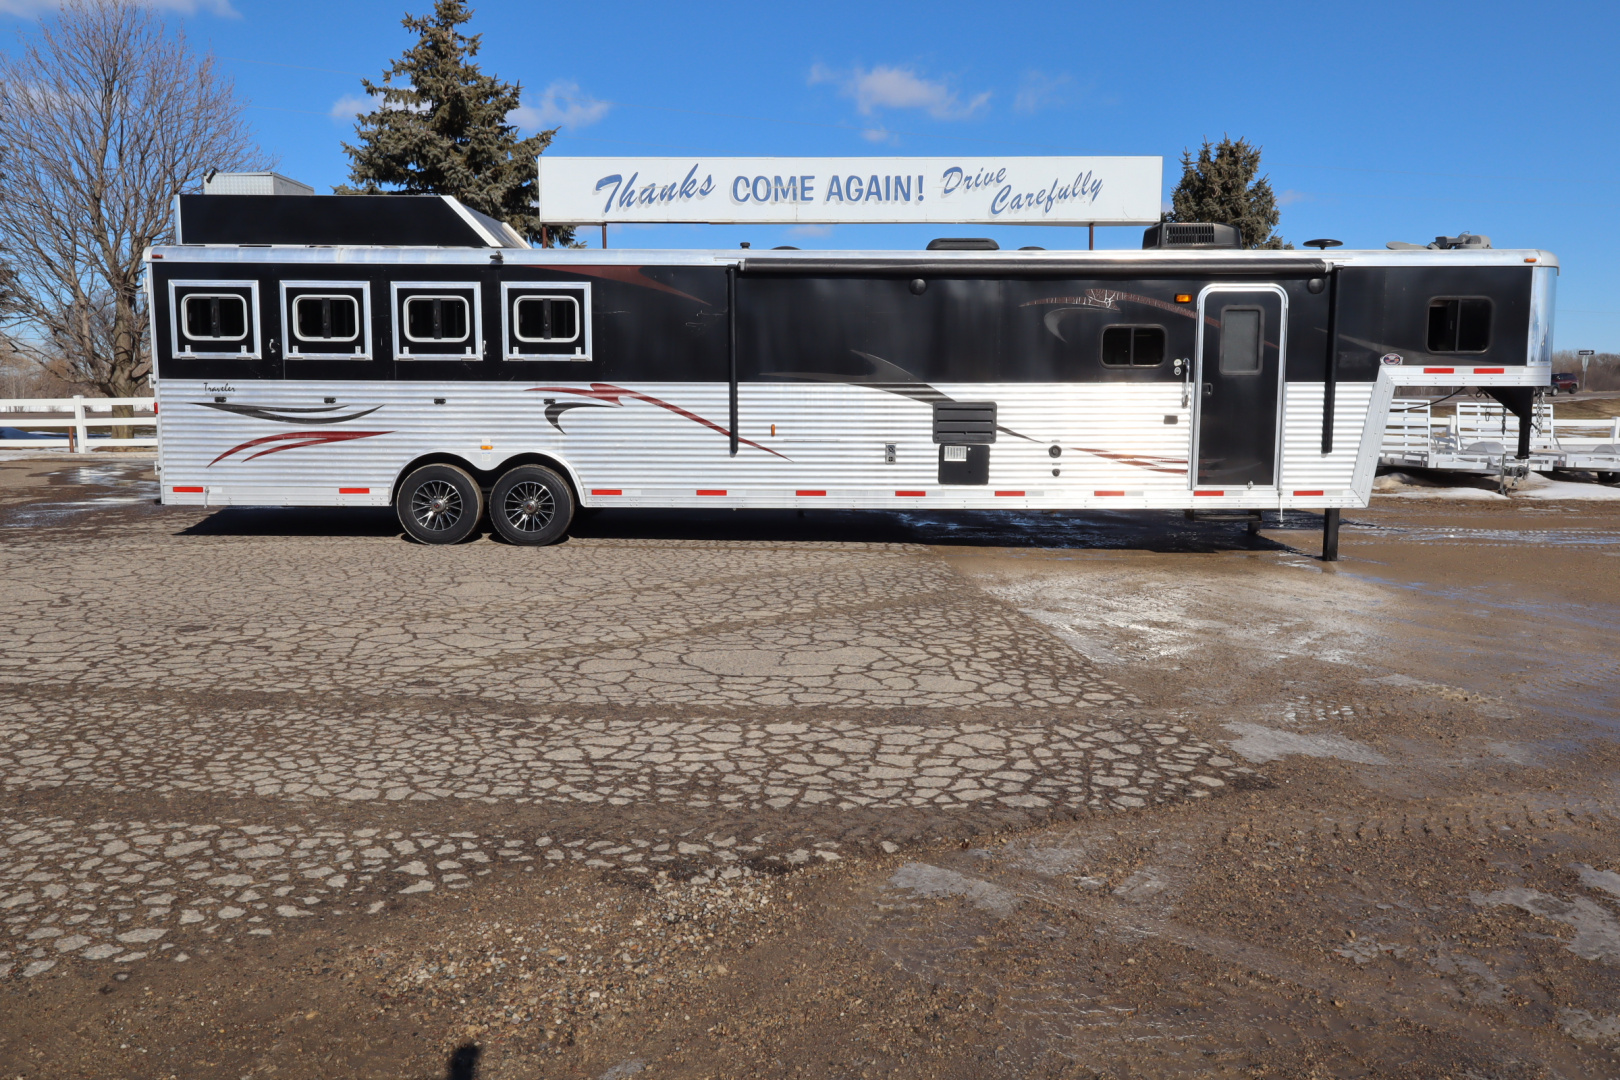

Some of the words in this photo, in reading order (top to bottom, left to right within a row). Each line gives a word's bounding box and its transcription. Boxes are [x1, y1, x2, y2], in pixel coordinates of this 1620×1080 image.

[595, 163, 716, 213] Thanks
[732, 175, 816, 203] COME
[826, 174, 925, 202] AGAIN!
[942, 166, 1007, 194] Drive
[990, 170, 1103, 215] Carefully
[203, 382, 236, 392] Traveler
